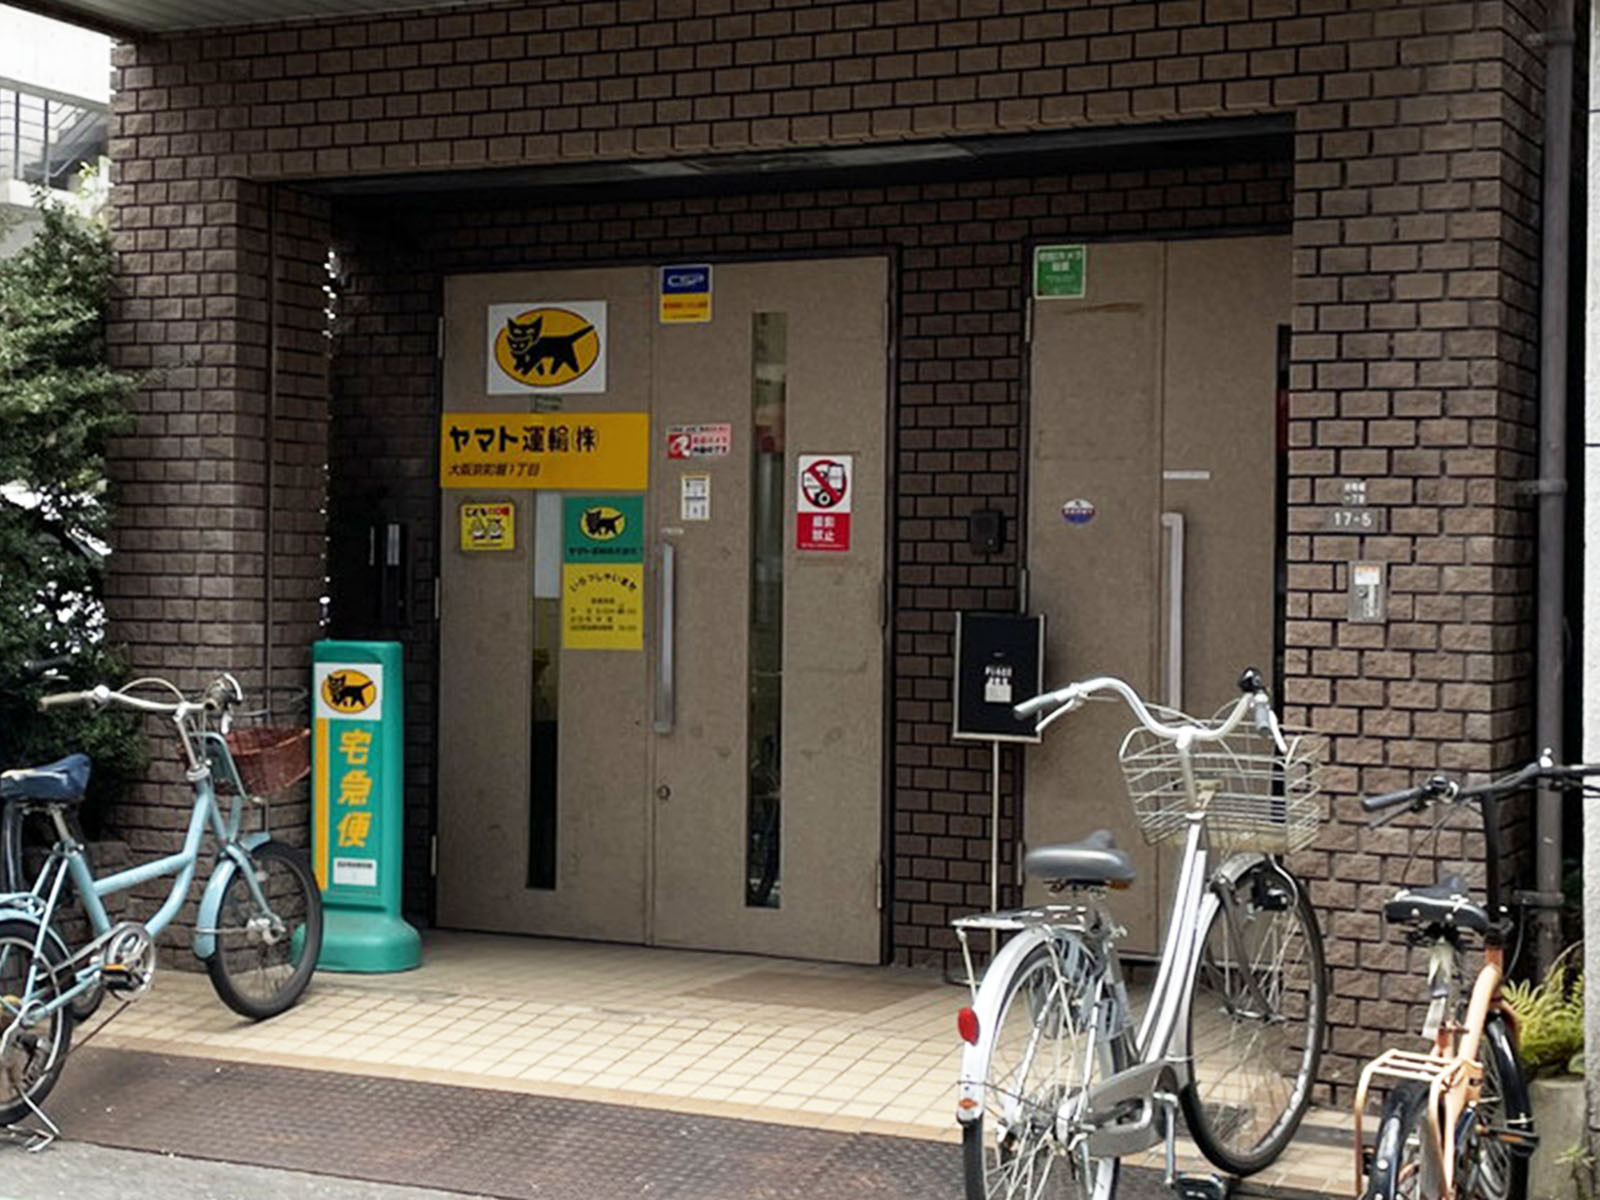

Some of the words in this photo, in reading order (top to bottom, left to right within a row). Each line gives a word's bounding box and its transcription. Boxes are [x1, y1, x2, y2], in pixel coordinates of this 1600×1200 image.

[1334, 511, 1372, 527] 17-5
[338, 728, 373, 848] 宅急便
